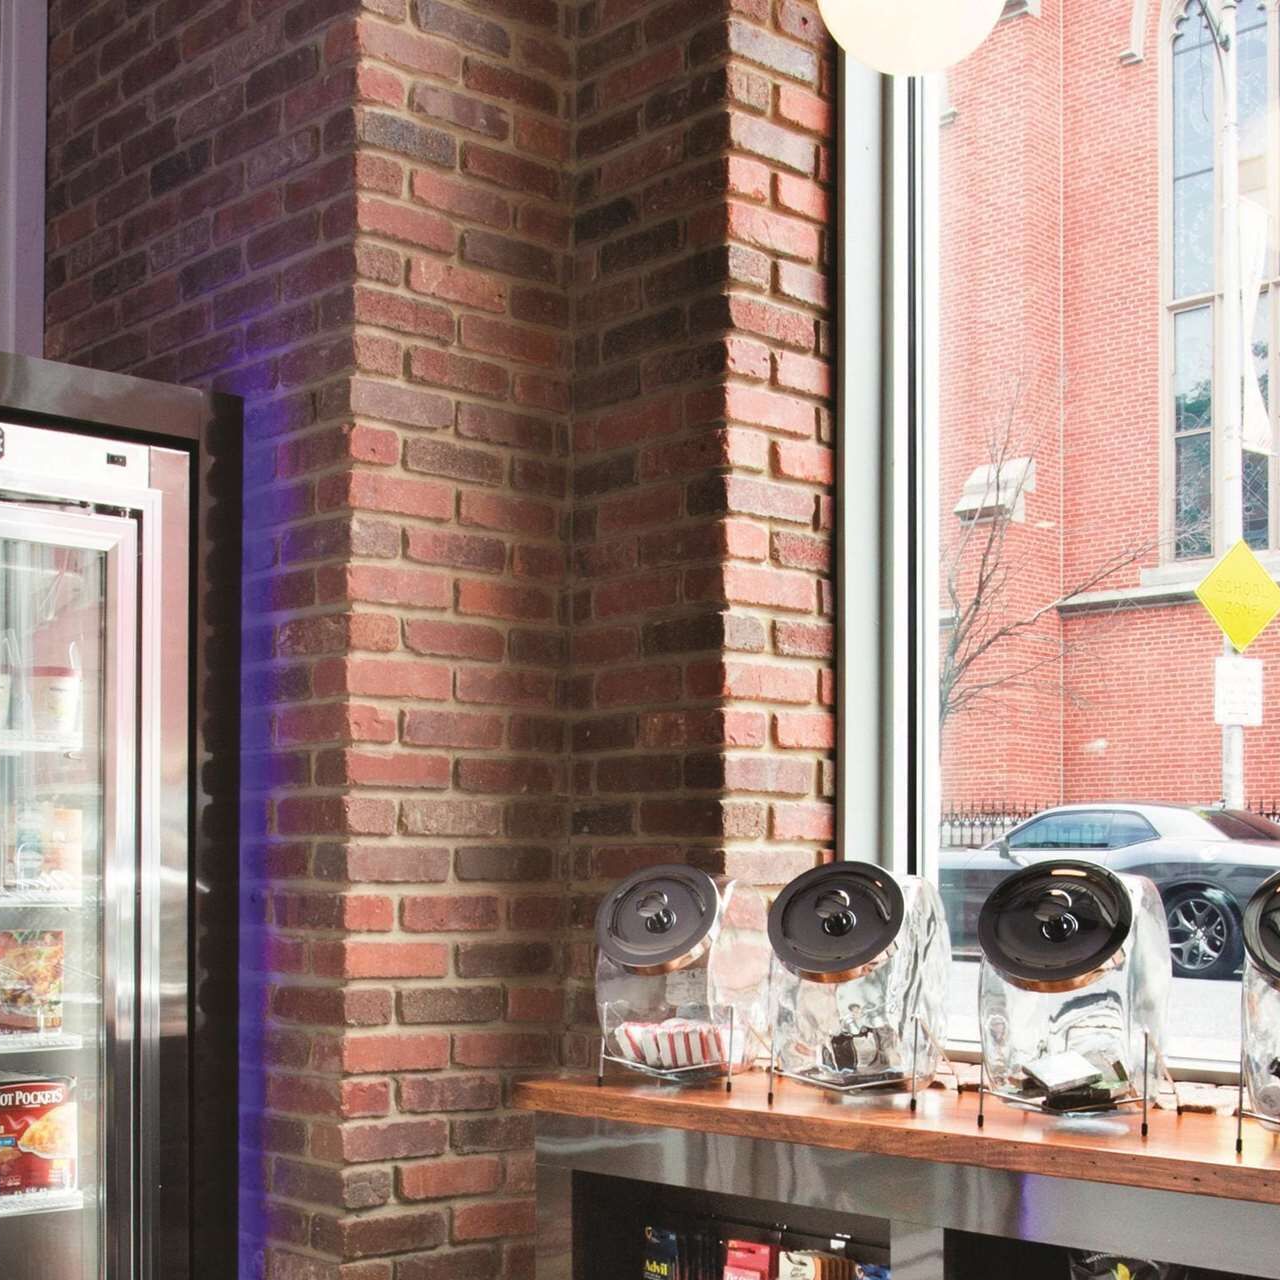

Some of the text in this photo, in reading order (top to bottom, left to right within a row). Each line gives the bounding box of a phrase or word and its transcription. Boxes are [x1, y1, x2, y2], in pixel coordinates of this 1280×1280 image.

[1215, 578, 1267, 599] SCHOOL
[15, 1087, 64, 1106] POCKETS
[644, 1258, 668, 1276] Advil
